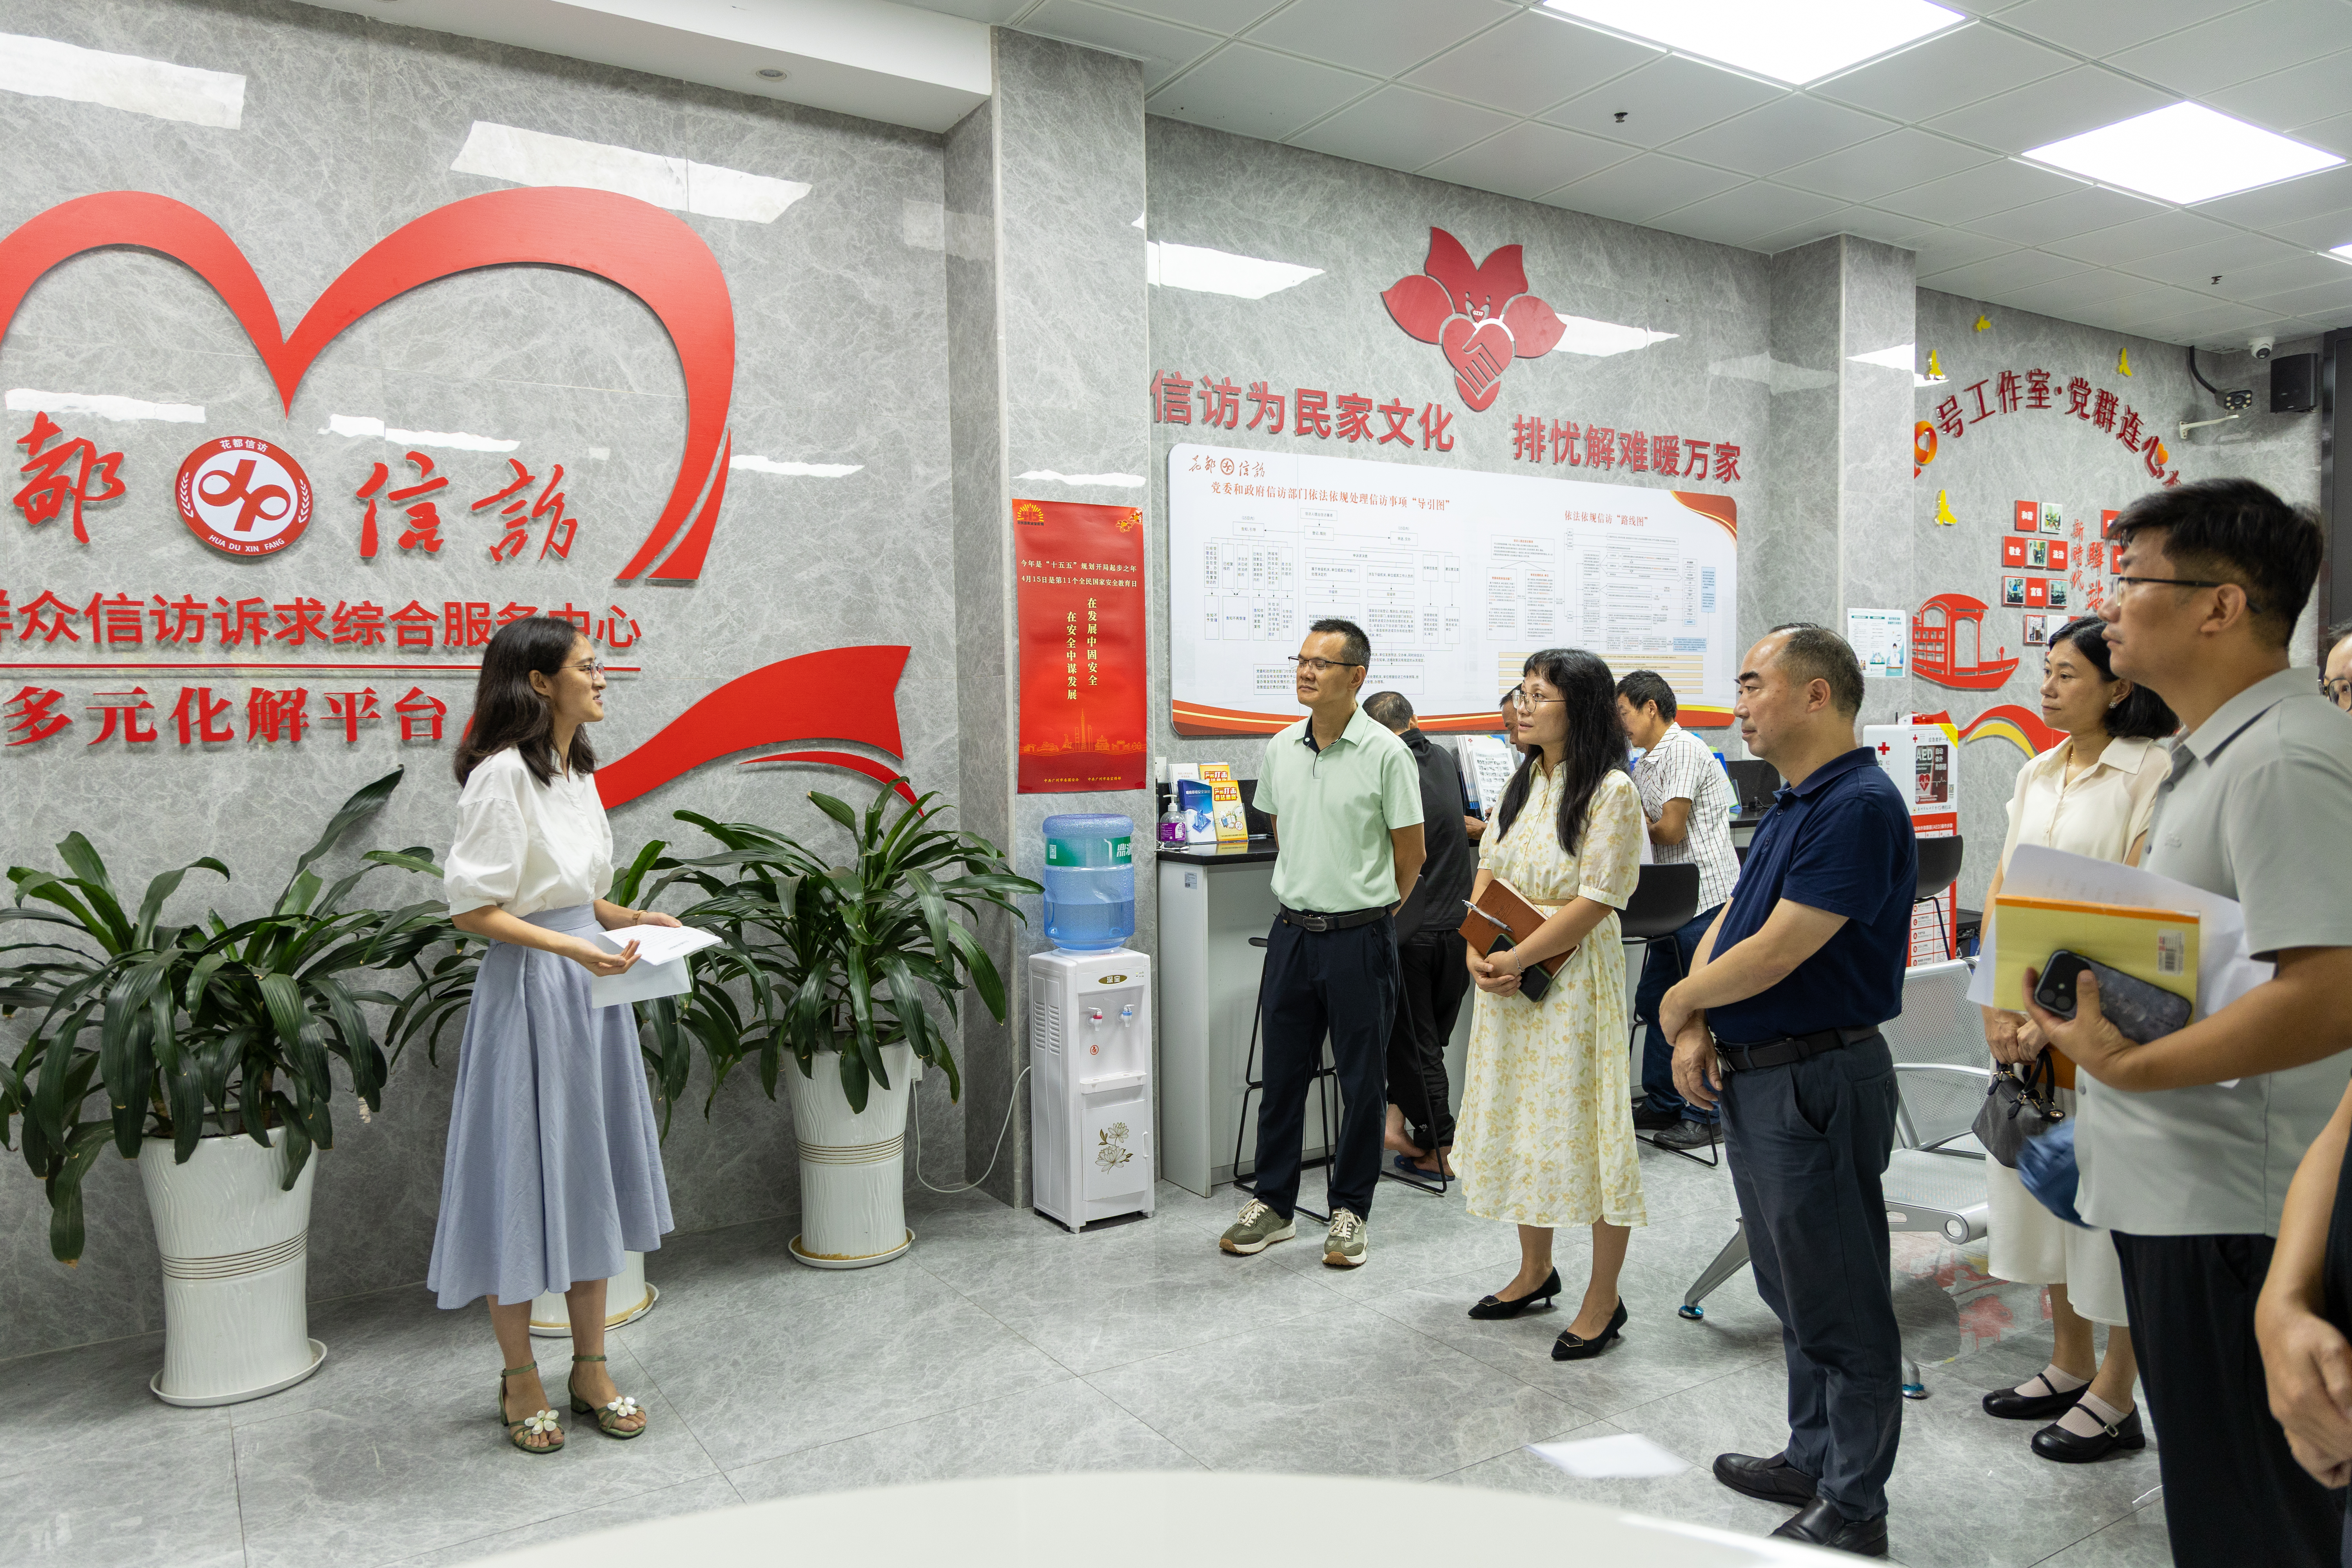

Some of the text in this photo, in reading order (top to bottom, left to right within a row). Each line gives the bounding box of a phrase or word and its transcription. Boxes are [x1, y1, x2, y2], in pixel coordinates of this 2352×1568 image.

[1151, 369, 1454, 452] 信访为民家文化
[220, 439, 268, 452] 花都信访
[1513, 415, 1741, 483] 排忧解难暖万家
[1211, 481, 1450, 510] 党委和政府信访部门依法依规处理信访事项“导引图”
[1564, 510, 1648, 527] 依法依规信访“路线图”
[209, 534, 226, 547] HUA
[229, 543, 241, 551] DU
[264, 538, 285, 550] FANG
[2053, 550, 2065, 559] 法治
[1021, 575, 1137, 587] 4月15日是第11个全民国家安全教育日
[2030, 587, 2042, 597] 富强
[1087, 597, 1098, 686] 在发展中固安全
[1066, 611, 1078, 701] 在安全中谋发展
[3, 686, 446, 746] 多元化解平台
[1916, 748, 1933, 760] AED
[1107, 975, 1120, 984] 深宝
